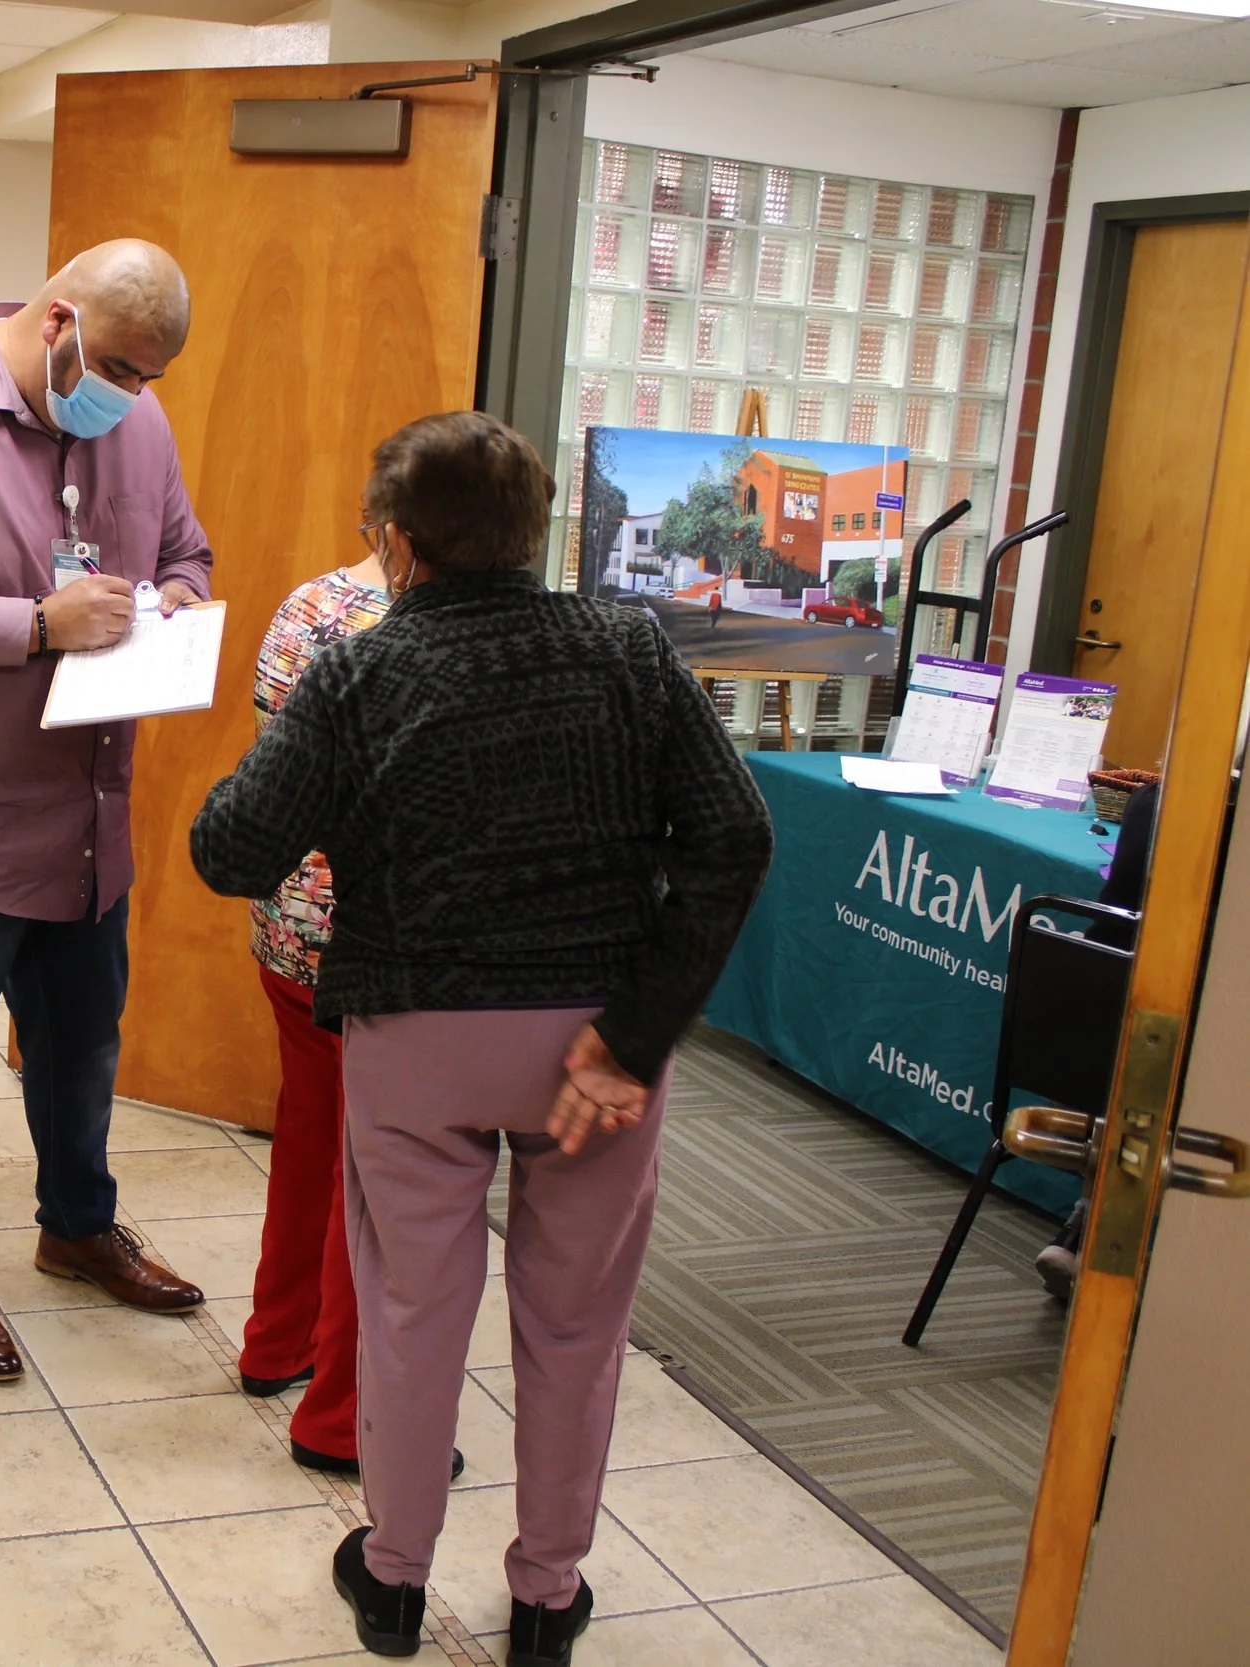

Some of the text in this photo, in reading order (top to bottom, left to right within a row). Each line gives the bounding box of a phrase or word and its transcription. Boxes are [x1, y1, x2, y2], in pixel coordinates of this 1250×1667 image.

[854, 829, 1085, 953] AltaM
[835, 901, 1008, 994] Your community heal
